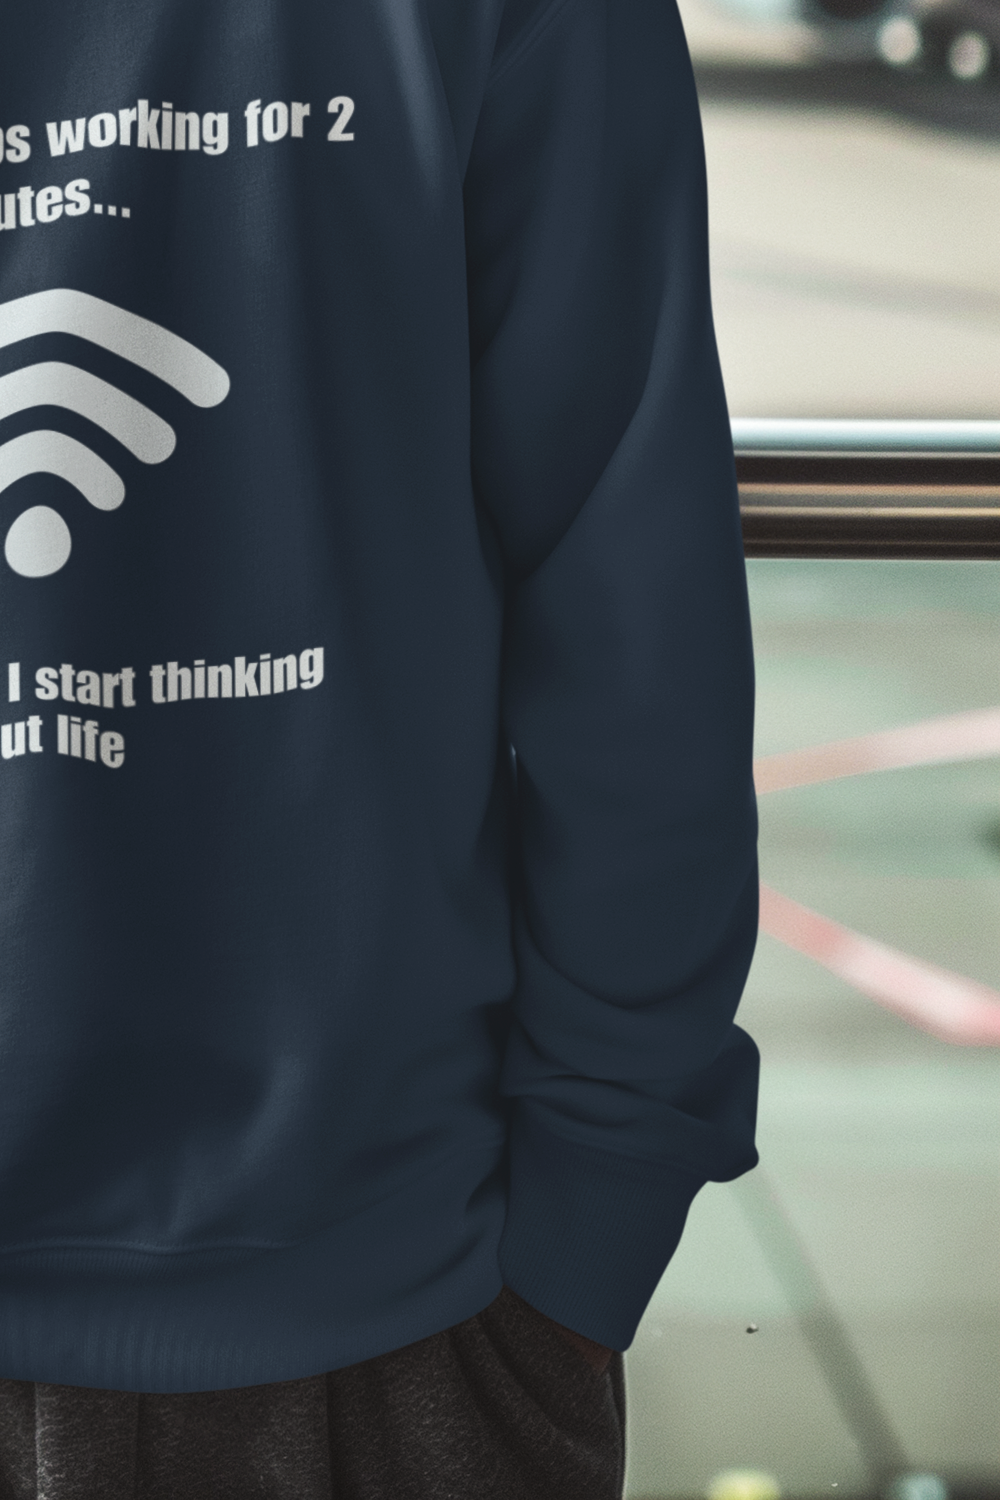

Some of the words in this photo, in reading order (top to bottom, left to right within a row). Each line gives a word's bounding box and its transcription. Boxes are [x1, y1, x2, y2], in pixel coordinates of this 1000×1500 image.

[45, 99, 229, 156] working
[244, 99, 310, 148] for
[327, 96, 355, 142] 2
[8, 662, 21, 703] I
[35, 663, 135, 708] start
[150, 647, 324, 703] thinking
[57, 714, 124, 768] life
